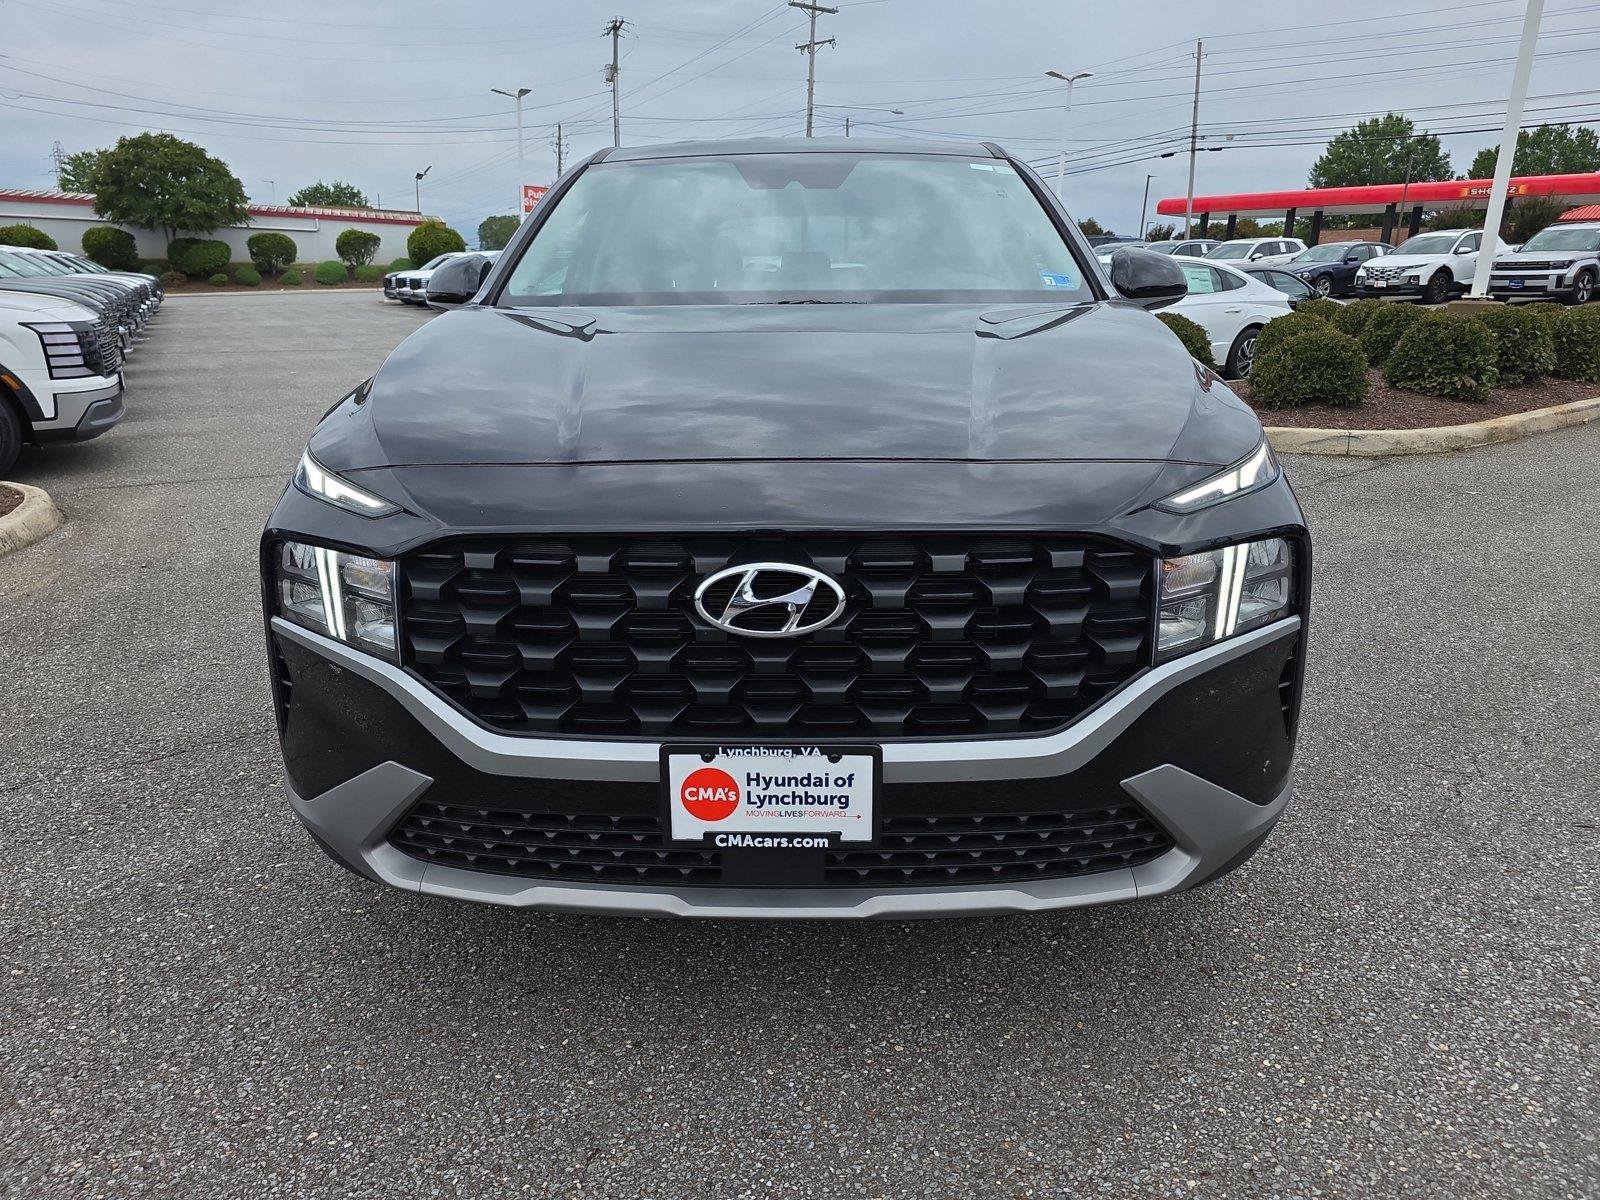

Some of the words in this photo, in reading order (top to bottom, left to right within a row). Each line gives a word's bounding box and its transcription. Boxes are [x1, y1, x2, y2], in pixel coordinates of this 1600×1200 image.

[527, 189, 546, 199] Pub
[1471, 186, 1516, 195] SHEZ
[523, 199, 539, 207] Sto
[719, 746, 796, 758] Lynchburg,
[800, 747, 822, 757] VA
[746, 772, 830, 791] Hyundai
[833, 773, 855, 788] of
[684, 787, 737, 802] CMA's
[746, 791, 850, 810] Lynchburg
[715, 834, 829, 848] CMAcars.com
